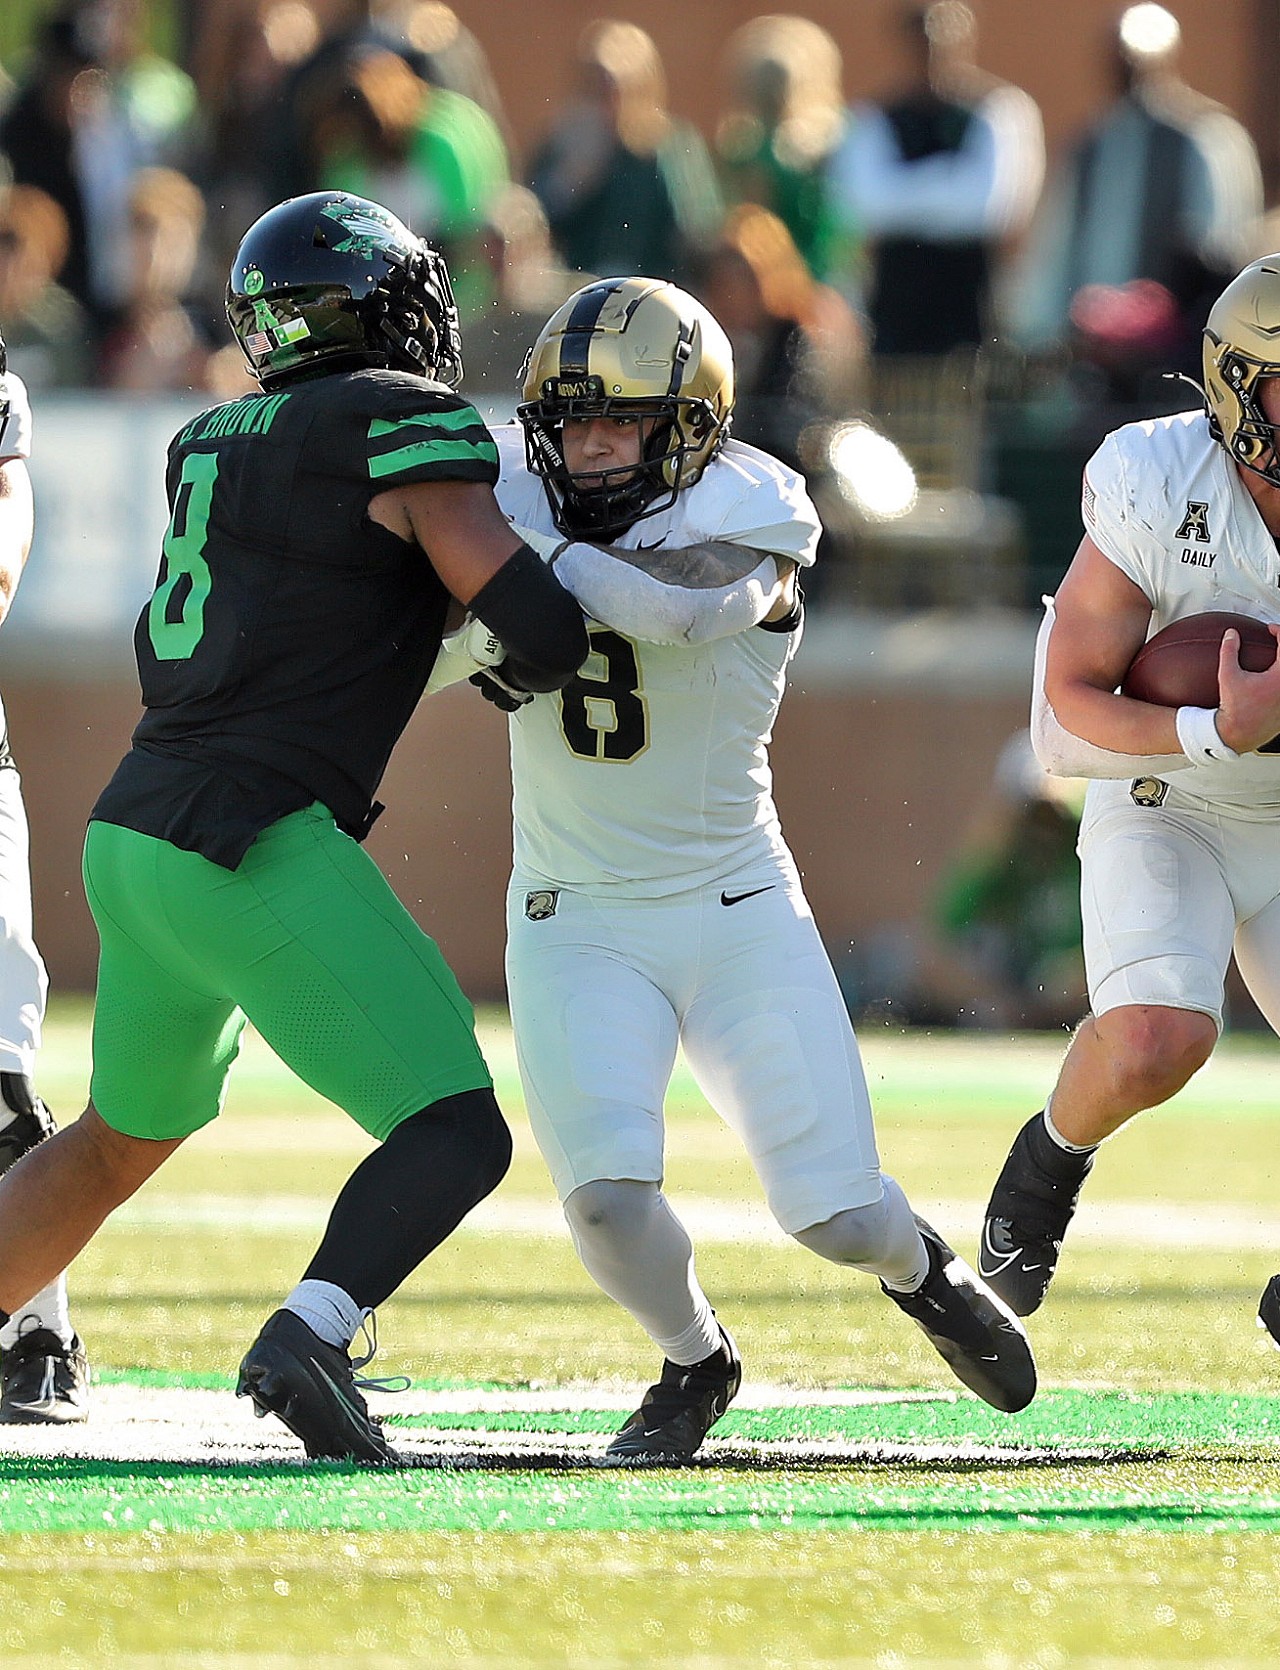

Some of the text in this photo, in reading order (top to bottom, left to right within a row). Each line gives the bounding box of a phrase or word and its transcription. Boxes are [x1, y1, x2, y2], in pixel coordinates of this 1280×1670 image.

[197, 394, 292, 440] BROWN
[537, 429, 563, 467] KNIGHTS
[150, 452, 220, 661] 8
[1181, 549, 1217, 568] DAILY
[558, 618, 652, 766] 8
